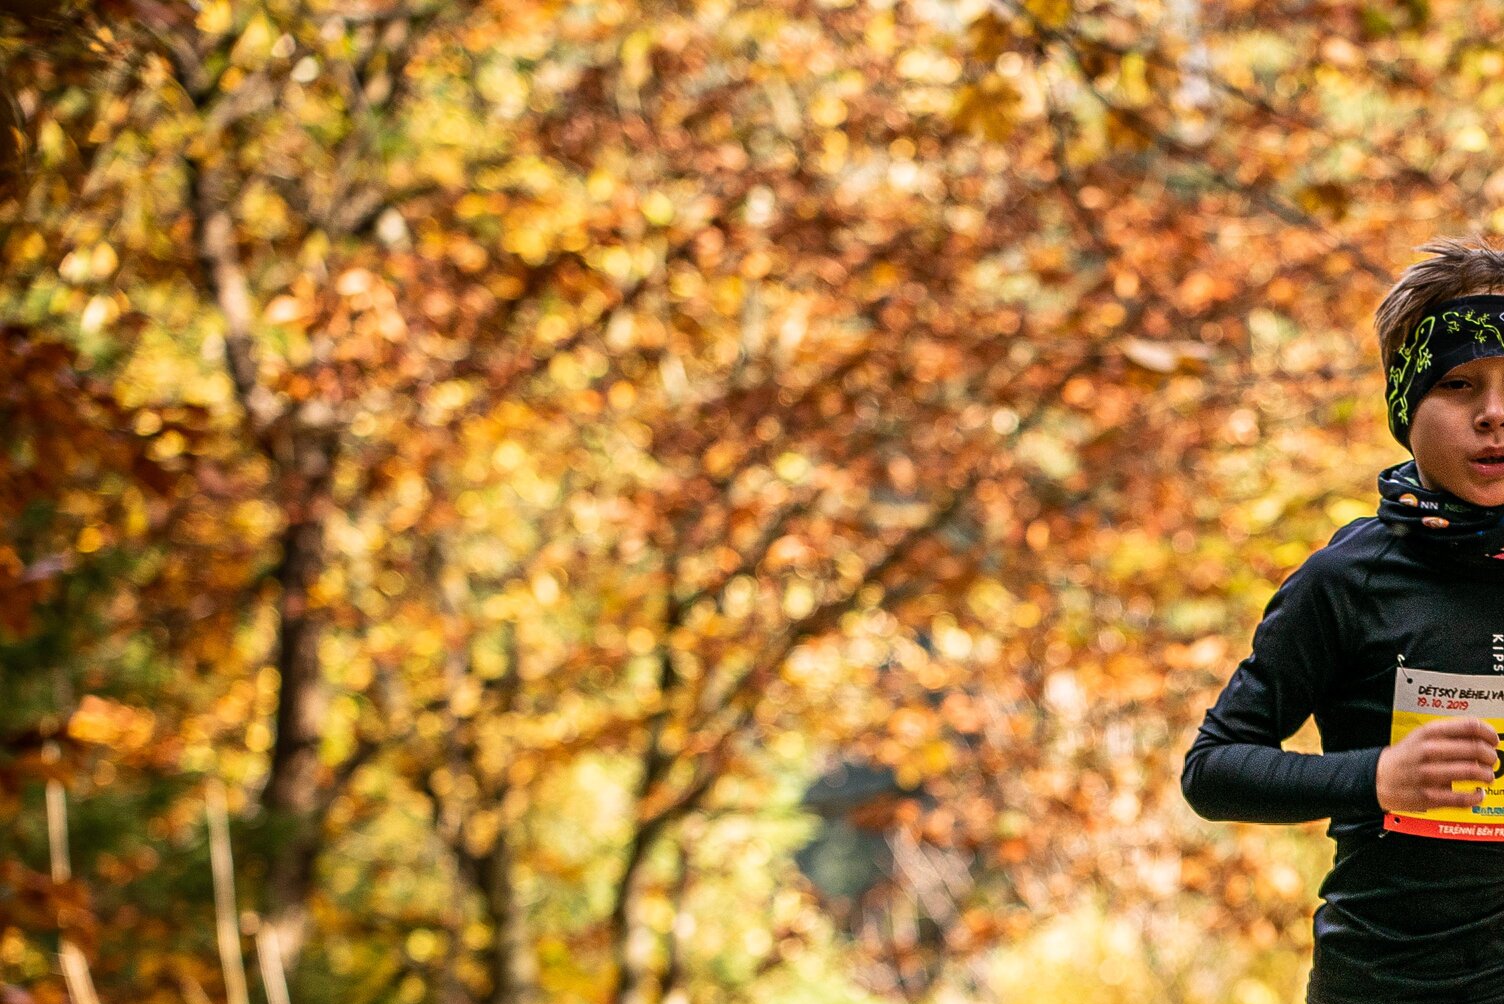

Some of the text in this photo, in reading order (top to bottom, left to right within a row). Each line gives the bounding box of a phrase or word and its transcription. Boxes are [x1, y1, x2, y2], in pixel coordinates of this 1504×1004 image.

[1418, 684, 1458, 698] DĚTSKÝ
[1459, 688, 1490, 700] BĚHEJ
[1438, 823, 1476, 836] TERÉNNÍ
